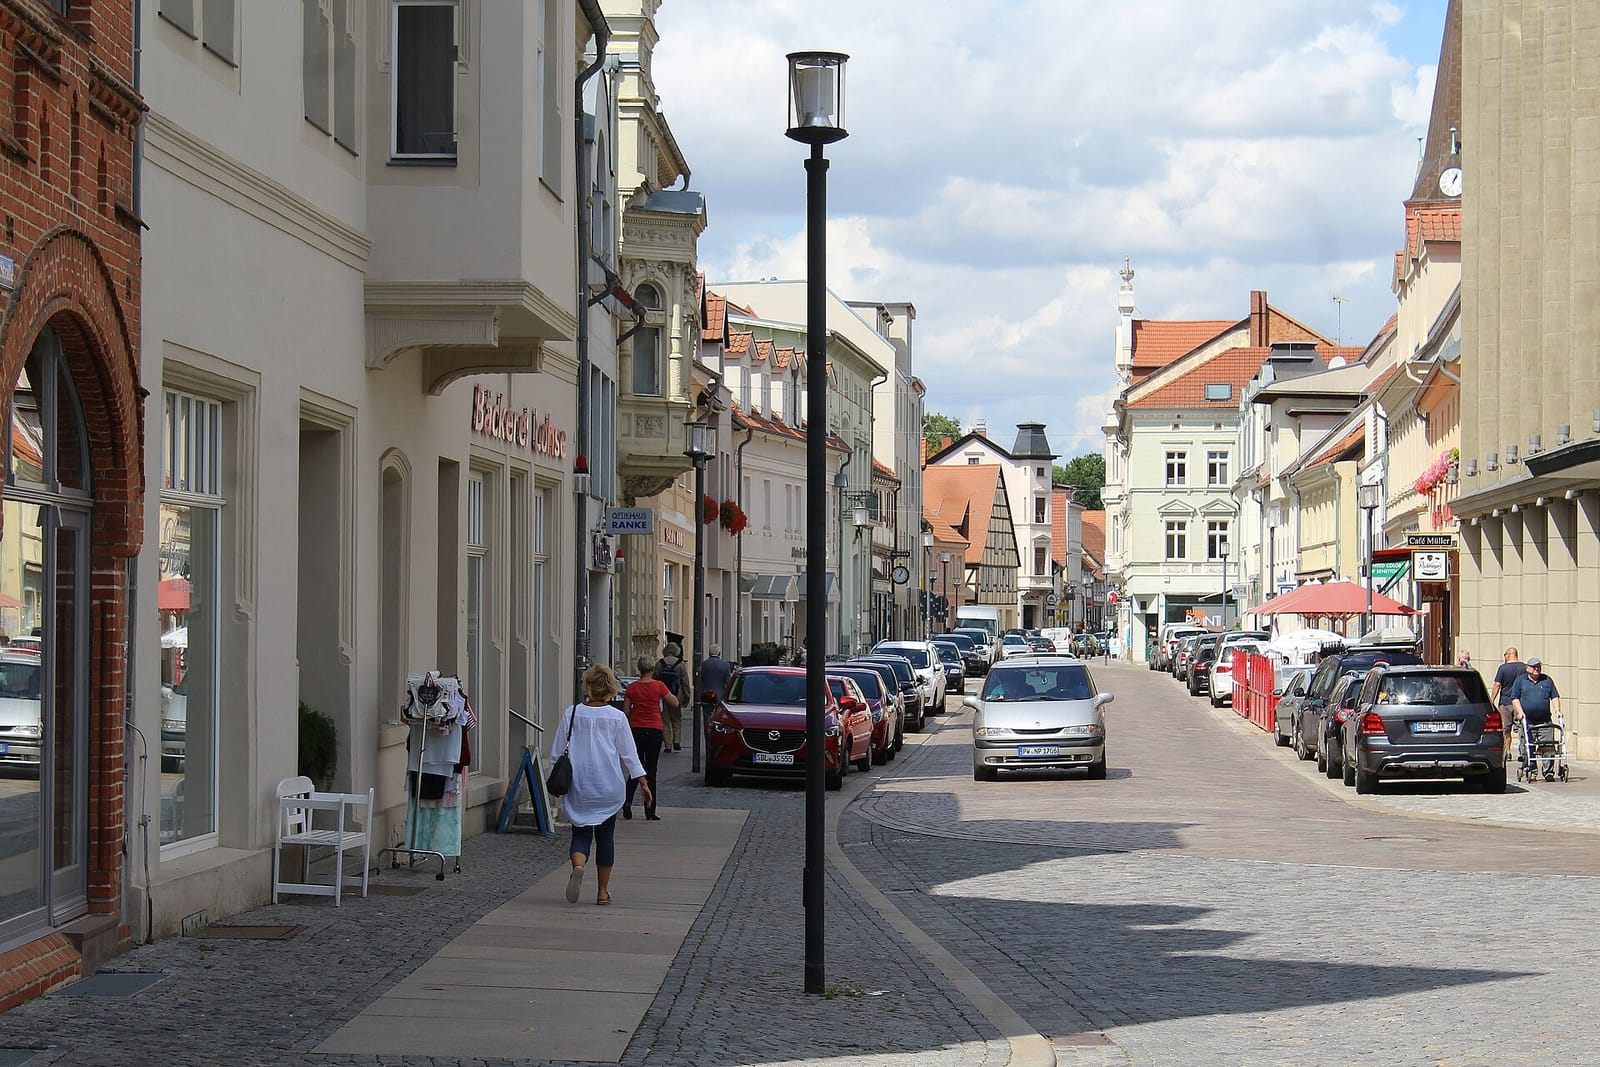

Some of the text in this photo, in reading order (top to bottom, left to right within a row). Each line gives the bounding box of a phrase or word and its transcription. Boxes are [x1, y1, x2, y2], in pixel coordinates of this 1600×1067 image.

[472, 384, 567, 459] Bäckerei Lohse
[611, 521, 647, 529] RANKE
[1409, 536, 1450, 545] Café Müller
[1185, 615, 1221, 628] POINT
